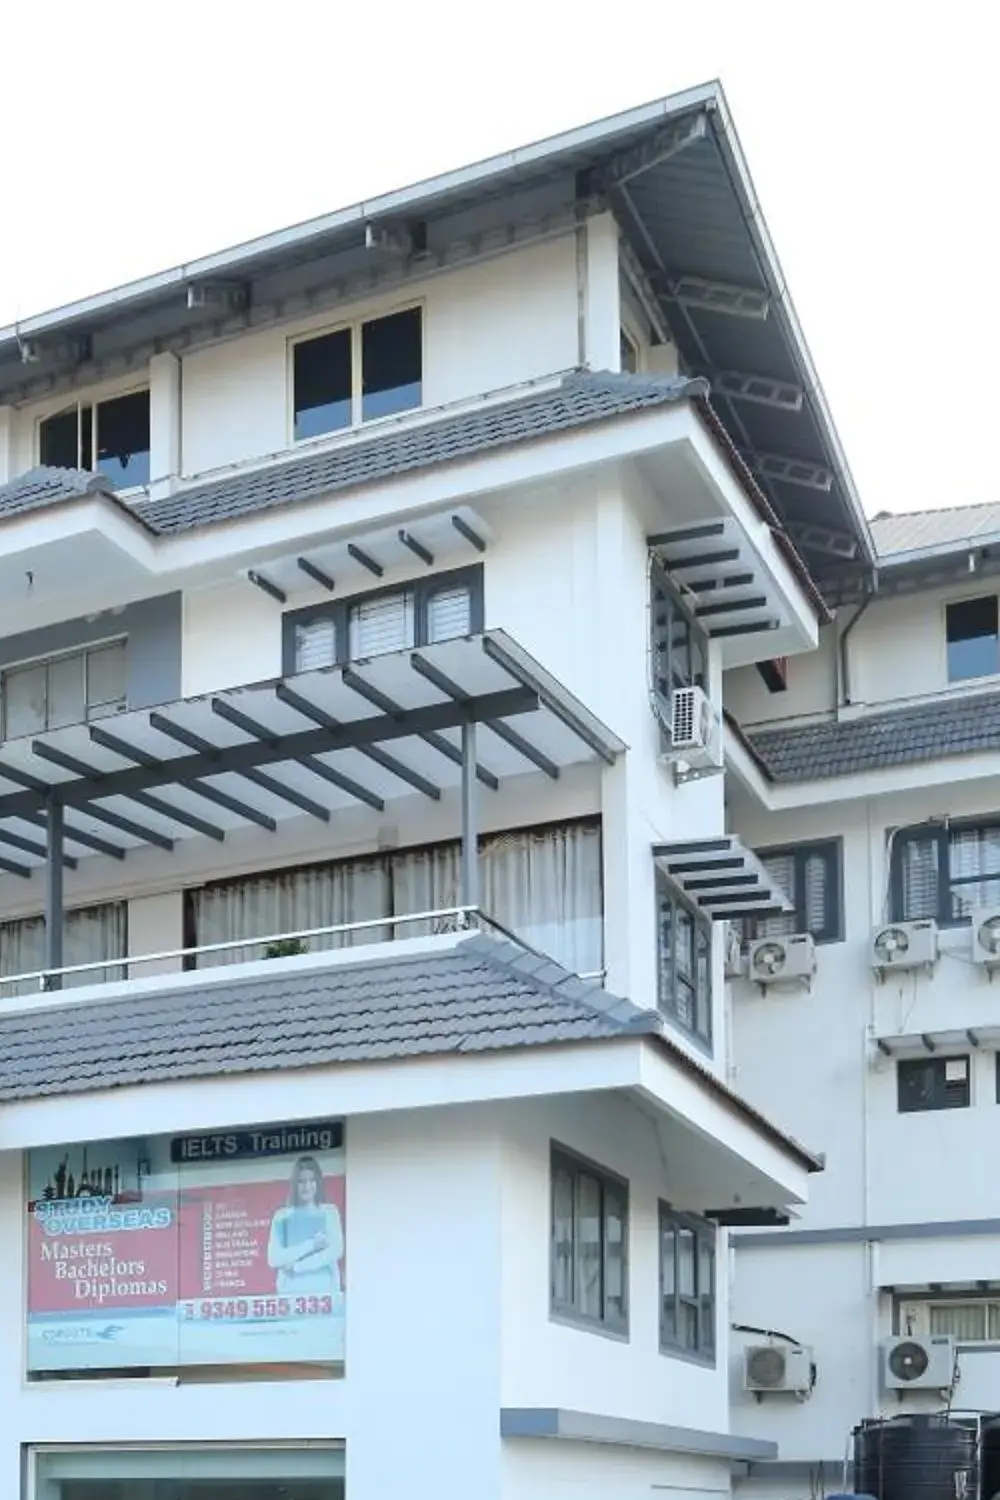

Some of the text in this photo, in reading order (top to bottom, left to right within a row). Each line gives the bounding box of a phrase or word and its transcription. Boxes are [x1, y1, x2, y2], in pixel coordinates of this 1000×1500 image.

[181, 1128, 332, 1159] IELTS Training
[45, 1208, 171, 1234] OVERSEAS
[41, 1242, 113, 1261] Masters
[55, 1258, 145, 1279] Bachelors
[74, 1278, 168, 1304] Diplomas
[252, 1298, 290, 1317] 555
[295, 1295, 333, 1315] 333
